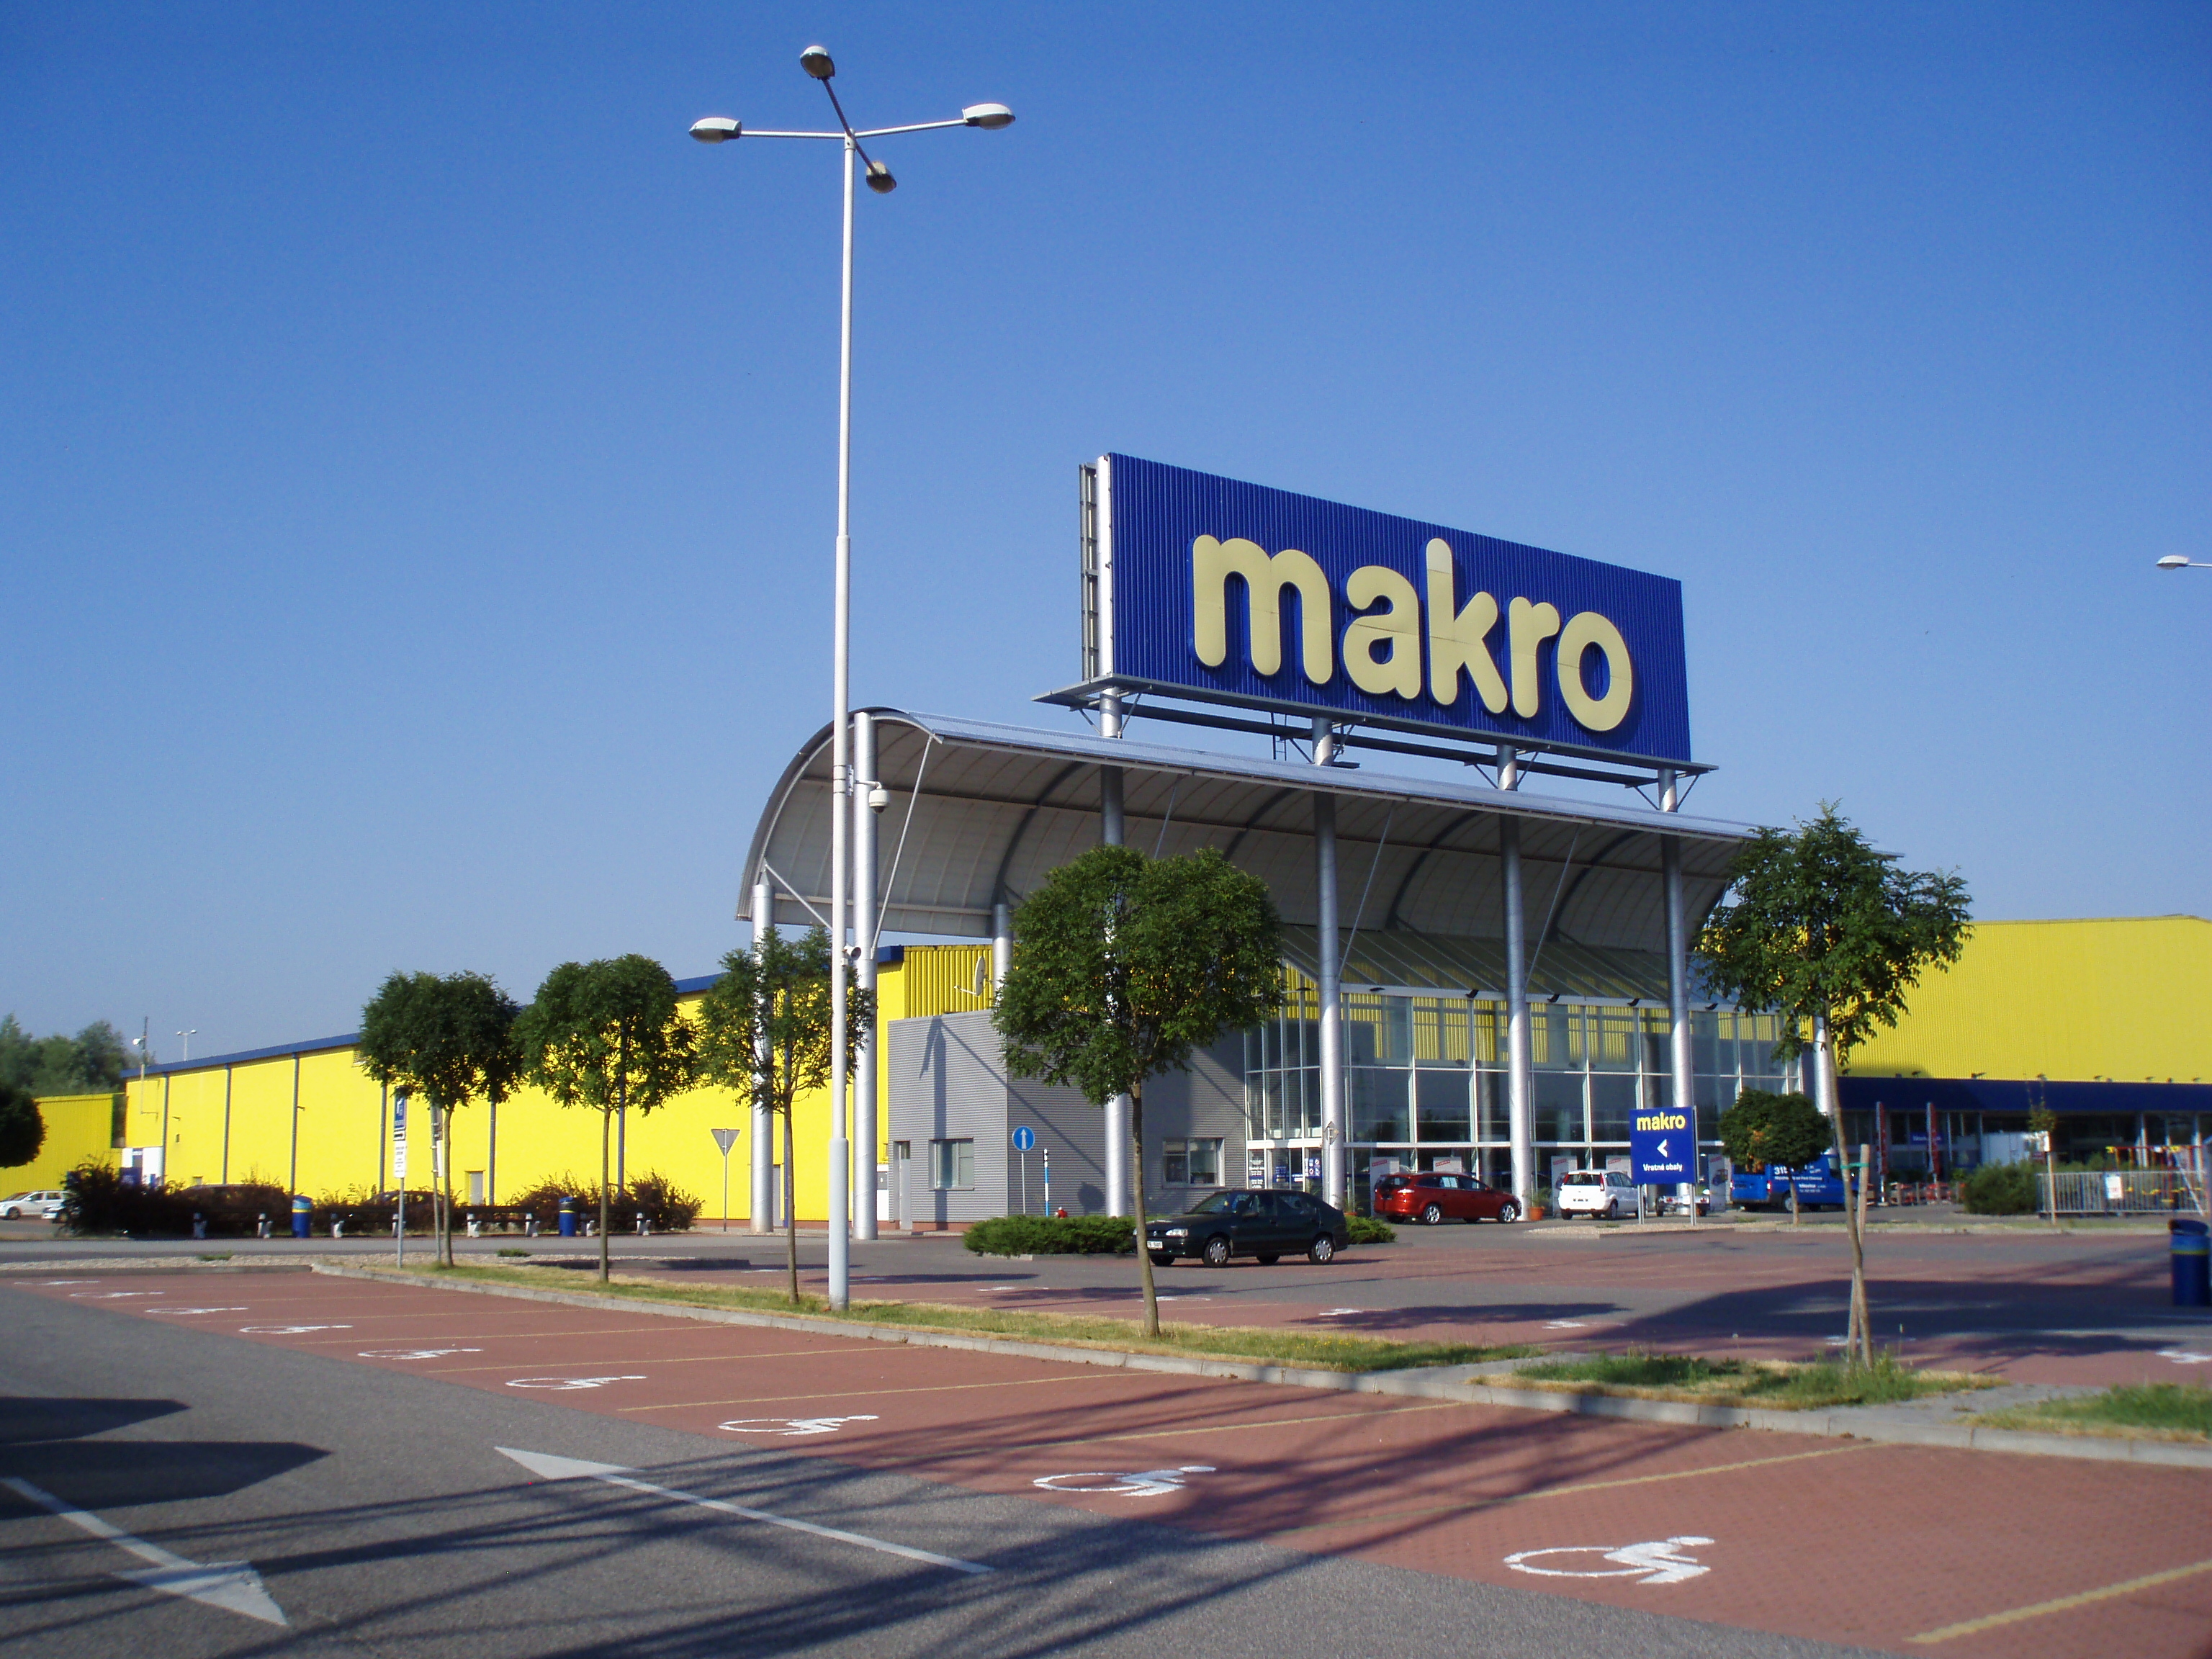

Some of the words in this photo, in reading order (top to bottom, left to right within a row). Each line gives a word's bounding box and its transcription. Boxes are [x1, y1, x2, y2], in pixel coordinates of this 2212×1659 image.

[1190, 534, 1633, 732] makro
[1636, 1111, 1686, 1131] makro
[1642, 1162, 1665, 1172] Vratné
[1665, 1161, 1683, 1172] obaly
